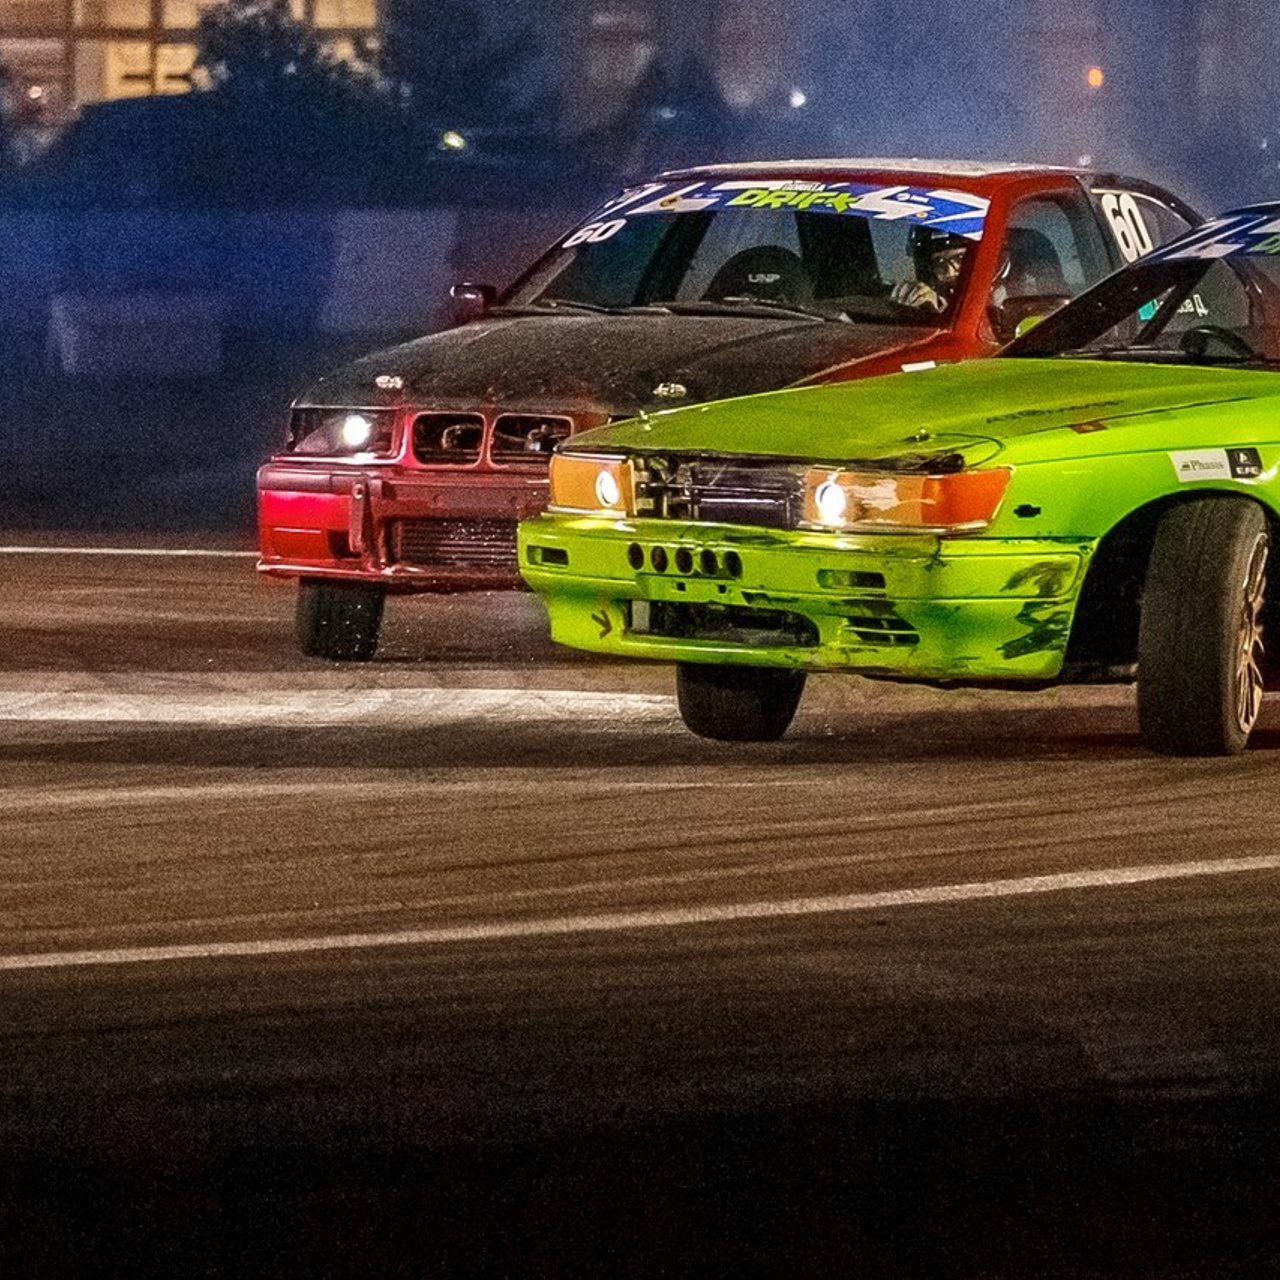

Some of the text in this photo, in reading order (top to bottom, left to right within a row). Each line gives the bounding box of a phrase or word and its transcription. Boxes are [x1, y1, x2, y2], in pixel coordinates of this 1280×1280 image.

[725, 189, 858, 212] DRIFT
[562, 219, 627, 248] 60
[1101, 193, 1154, 263] 60
